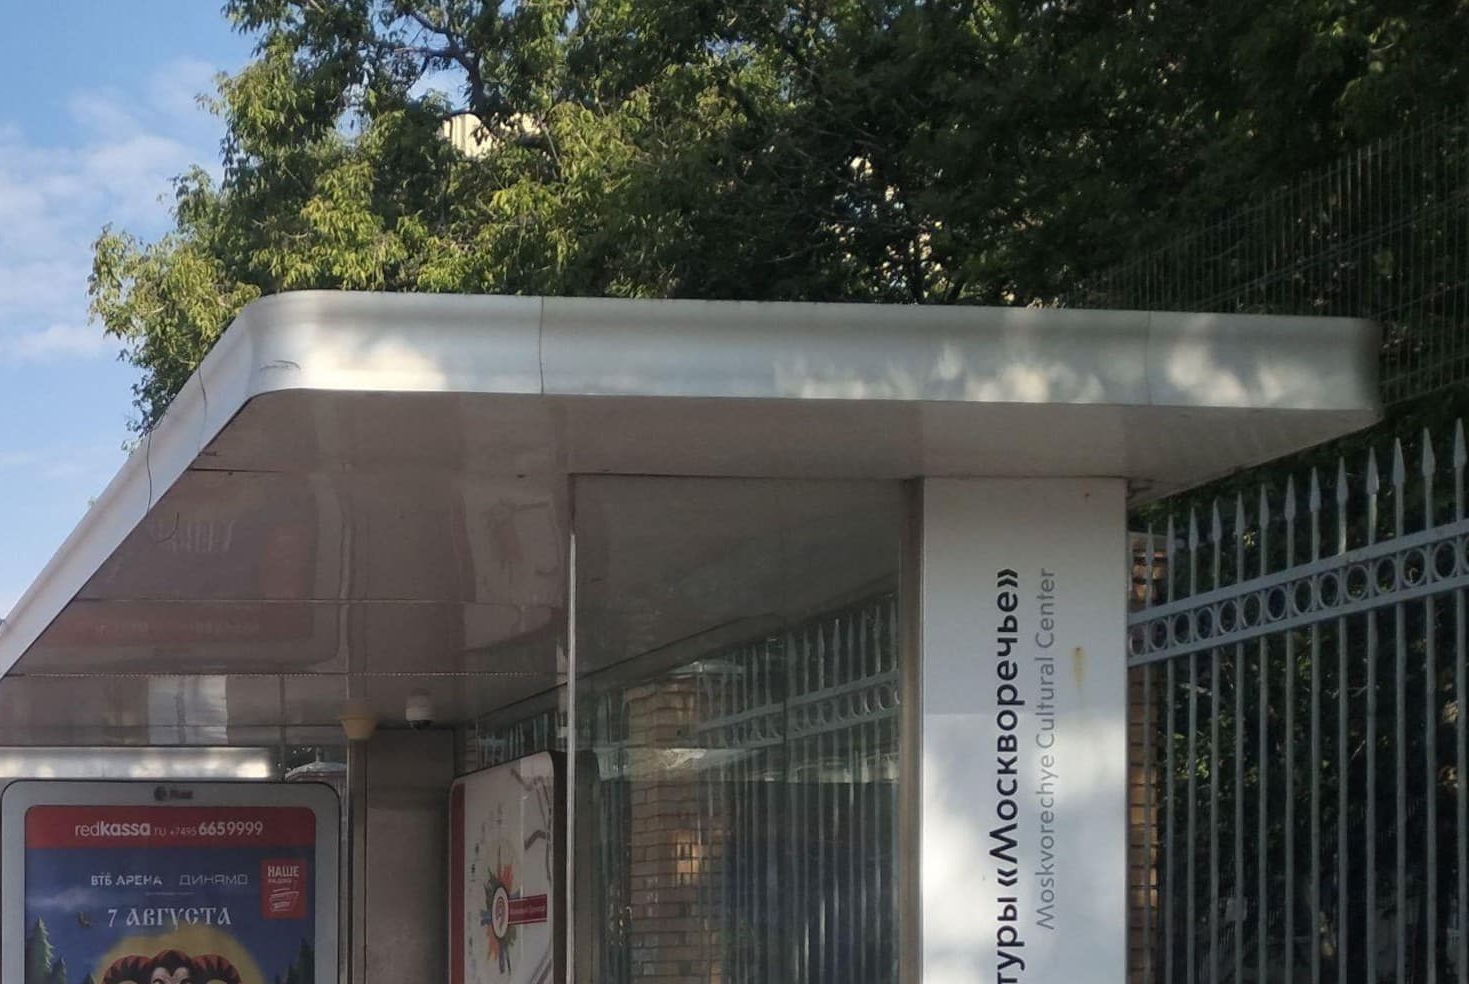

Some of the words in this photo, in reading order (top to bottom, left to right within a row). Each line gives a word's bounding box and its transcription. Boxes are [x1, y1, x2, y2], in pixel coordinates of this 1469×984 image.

[1035, 567, 1056, 649] Center
[989, 567, 1026, 887] «Москворечье»
[1035, 656, 1056, 750] Cultural
[198, 821, 263, 837] 6659999
[1035, 755, 1060, 931] Moskvorechye
[91, 873, 112, 886] ВТБ
[116, 875, 163, 886] АРЕНА
[179, 874, 248, 886] ДИНАМО
[267, 866, 299, 877] НАШЕ
[108, 909, 117, 928] 7
[126, 907, 232, 930] АВГУСТА
